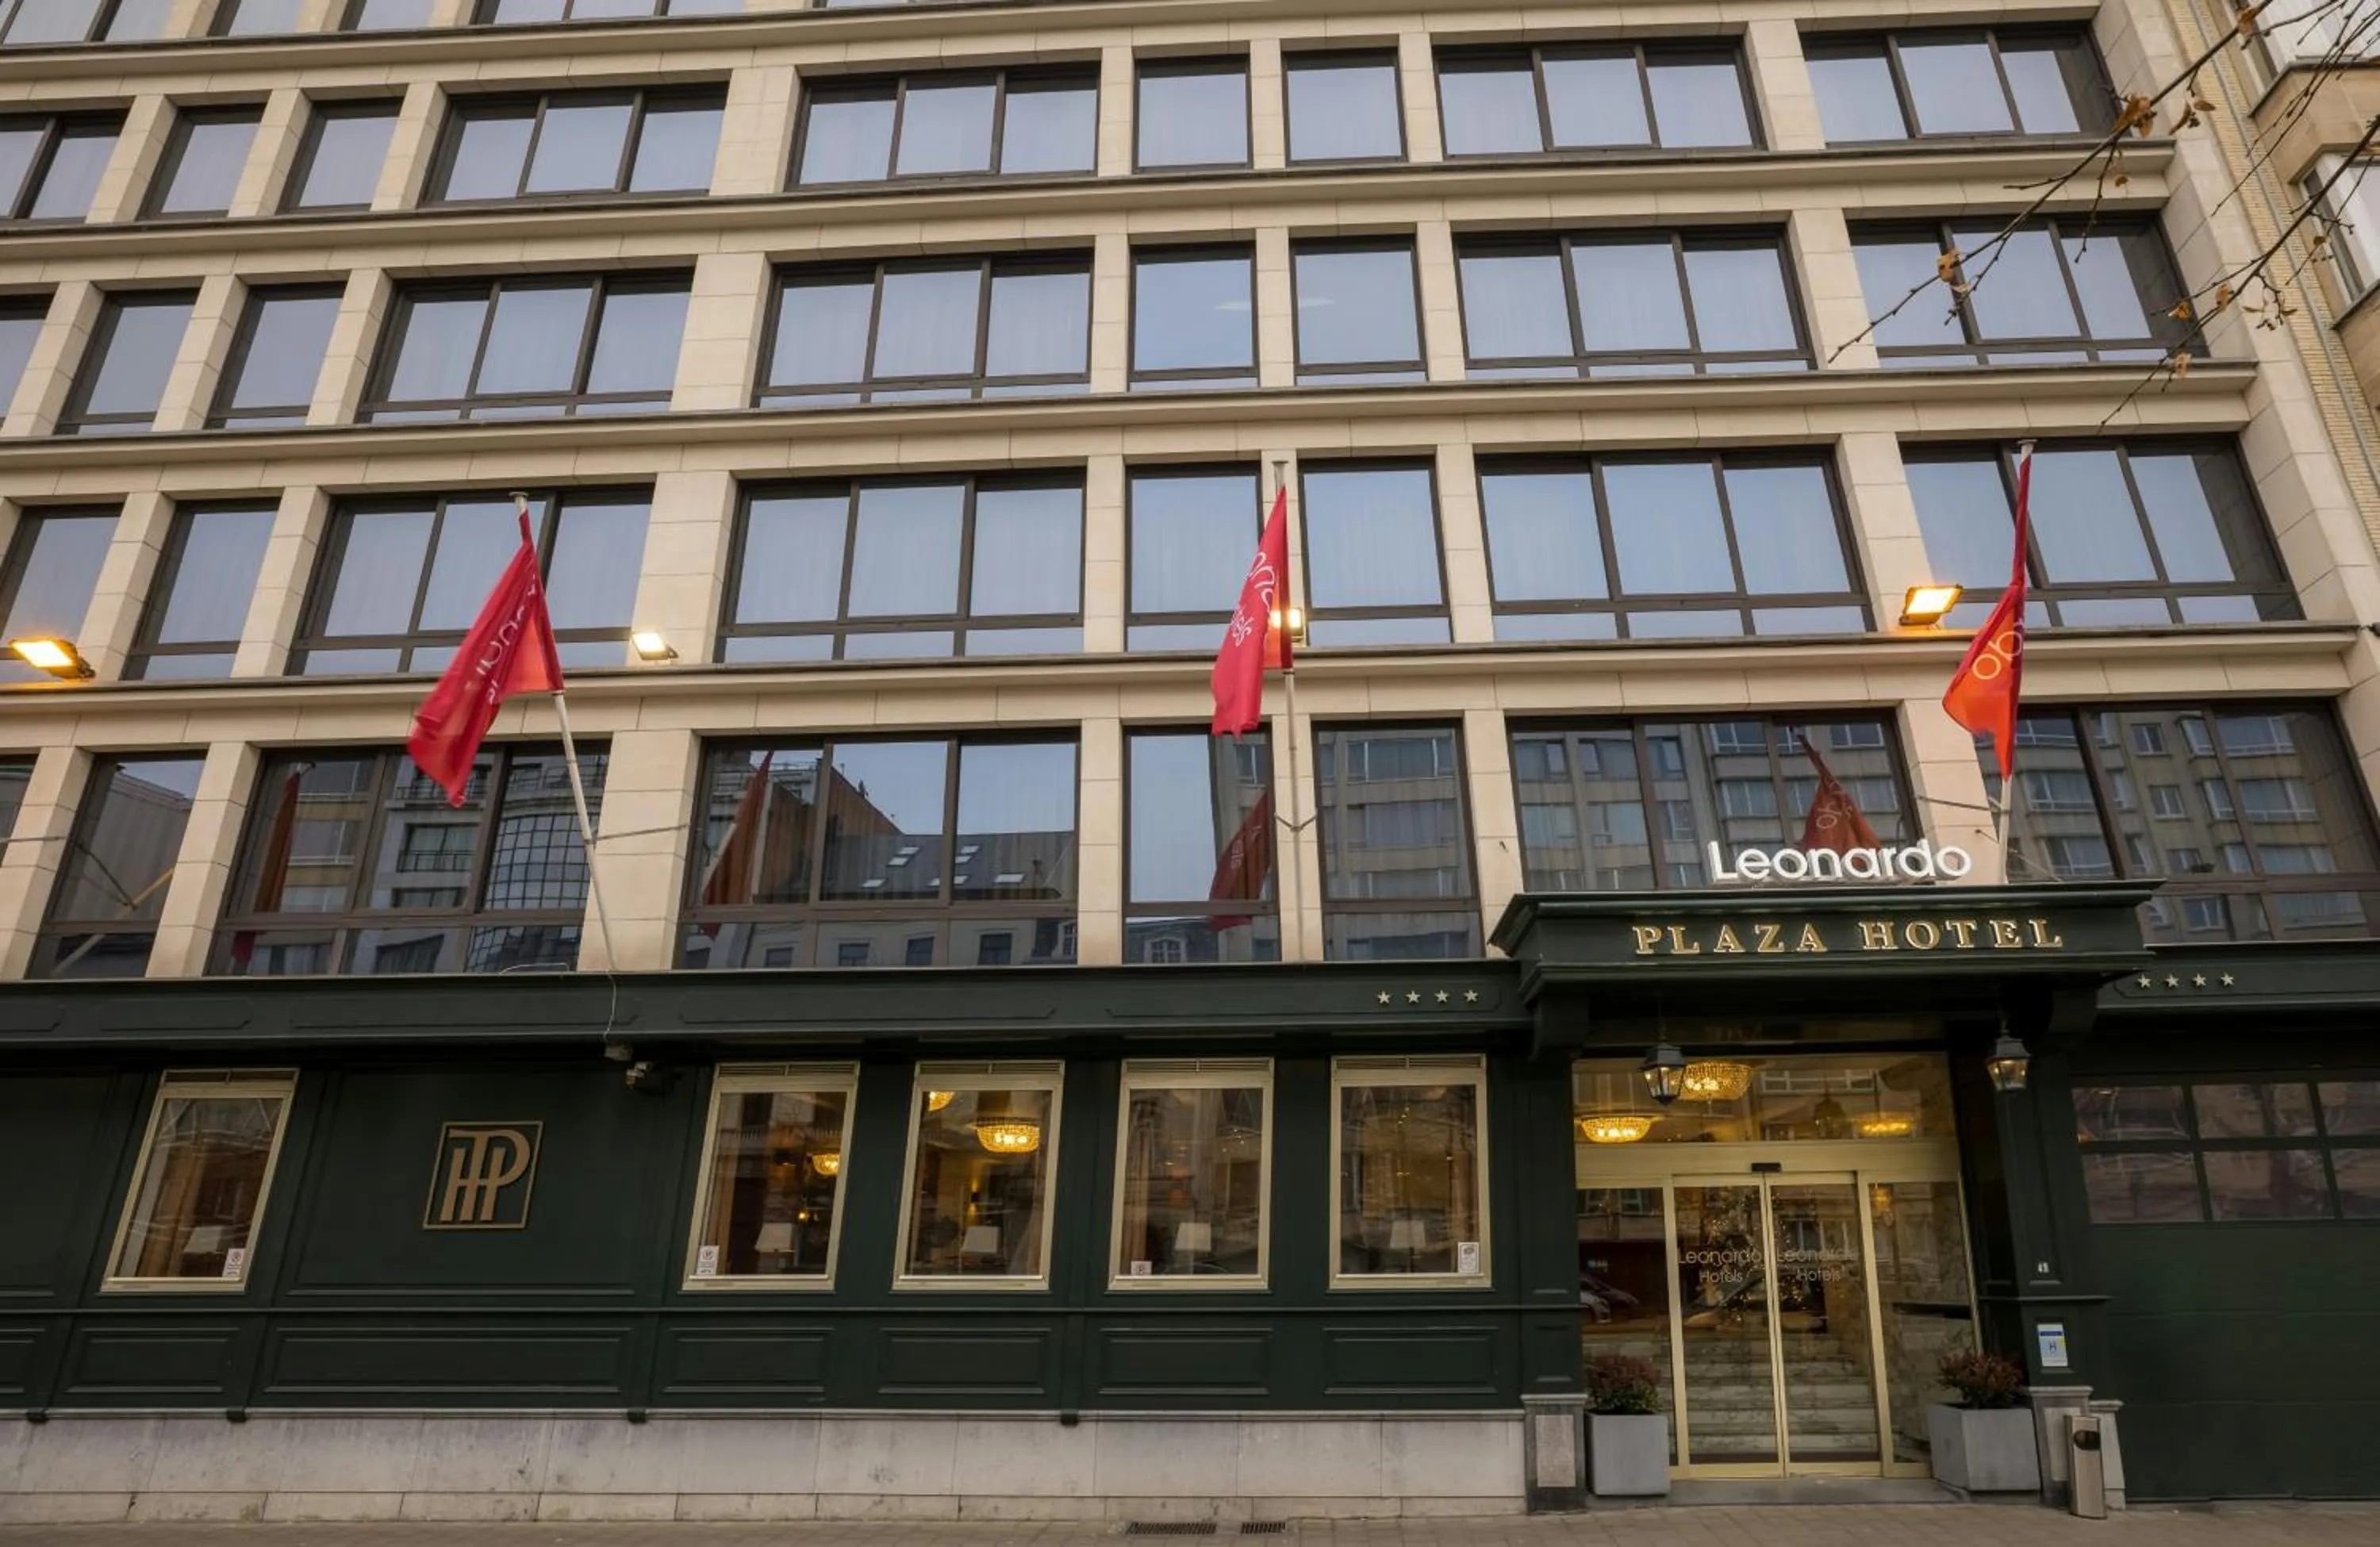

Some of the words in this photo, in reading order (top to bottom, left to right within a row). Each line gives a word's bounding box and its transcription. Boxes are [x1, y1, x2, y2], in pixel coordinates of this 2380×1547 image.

[1706, 838, 1972, 882] Leonardo
[1632, 923, 1828, 954] PLAZA
[1857, 919, 2063, 950] HOTEL
[1678, 1248, 1762, 1265] Leonardo
[1699, 1269, 1744, 1284] Hotels
